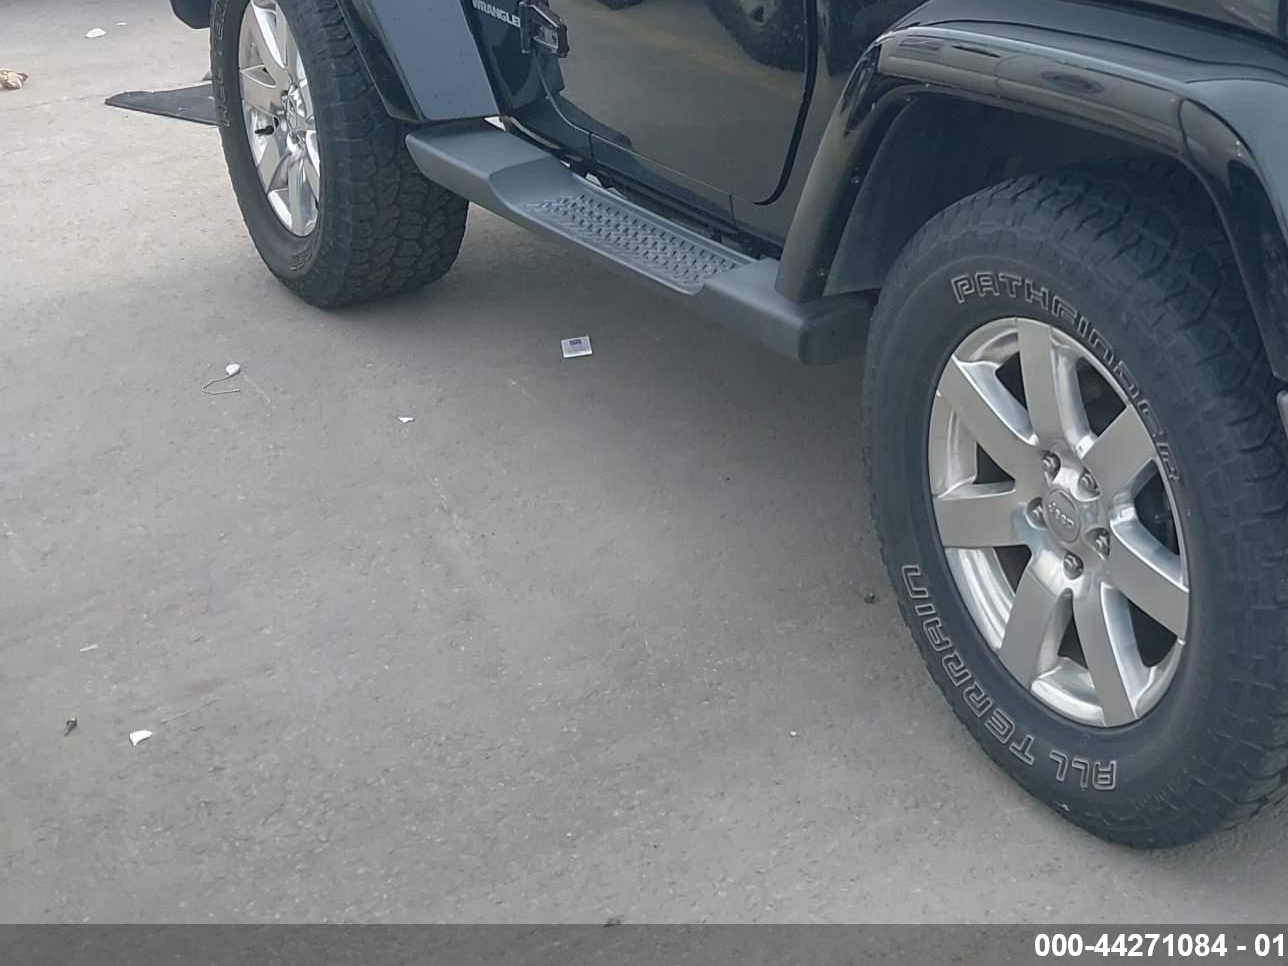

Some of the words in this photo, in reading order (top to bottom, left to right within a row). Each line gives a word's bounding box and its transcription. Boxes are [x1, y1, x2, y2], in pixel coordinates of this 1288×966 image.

[949, 271, 1181, 483] PATHFINDER
[900, 564, 1037, 767] TERRAIN
[1048, 749, 1120, 792] ALL
